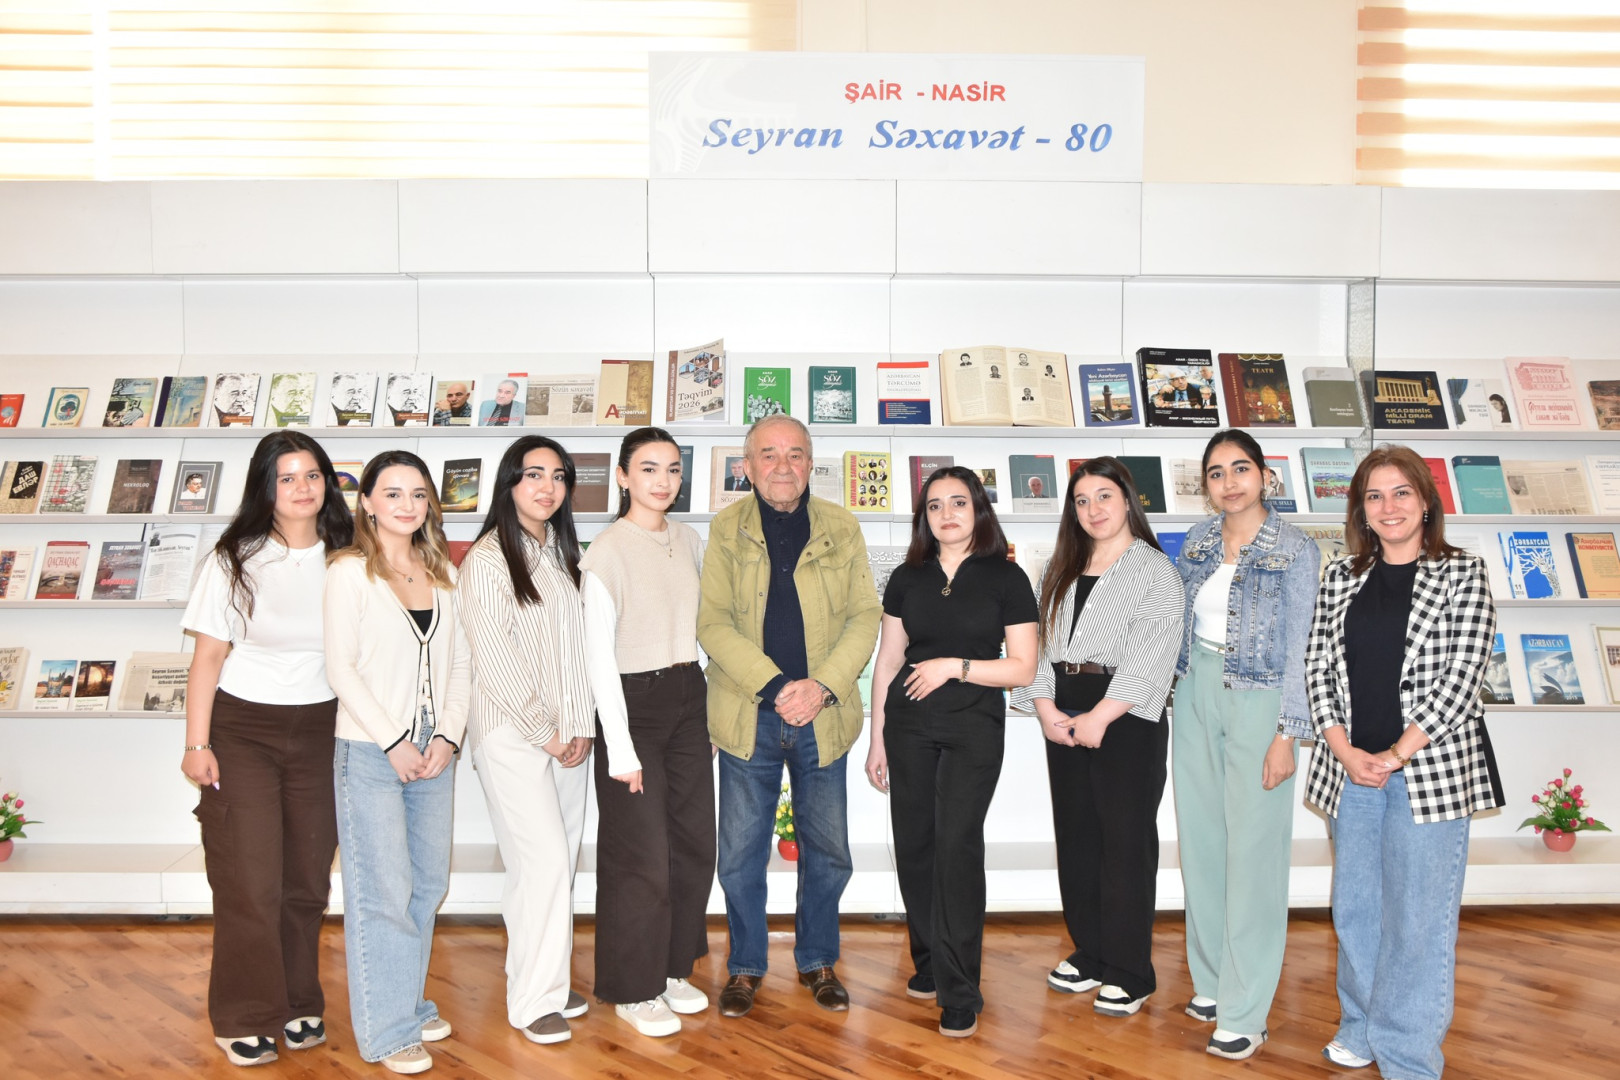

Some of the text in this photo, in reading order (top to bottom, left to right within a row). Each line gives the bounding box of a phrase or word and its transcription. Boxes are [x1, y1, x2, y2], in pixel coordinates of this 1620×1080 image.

[844, 80, 902, 104] ŞAİR
[932, 80, 1006, 102] NASİR
[702, 118, 843, 155] Seyran
[868, 119, 1025, 151] Səxavət
[1064, 122, 1113, 152] 80
[678, 388, 713, 401] Təqvim
[678, 401, 701, 410] 2026
